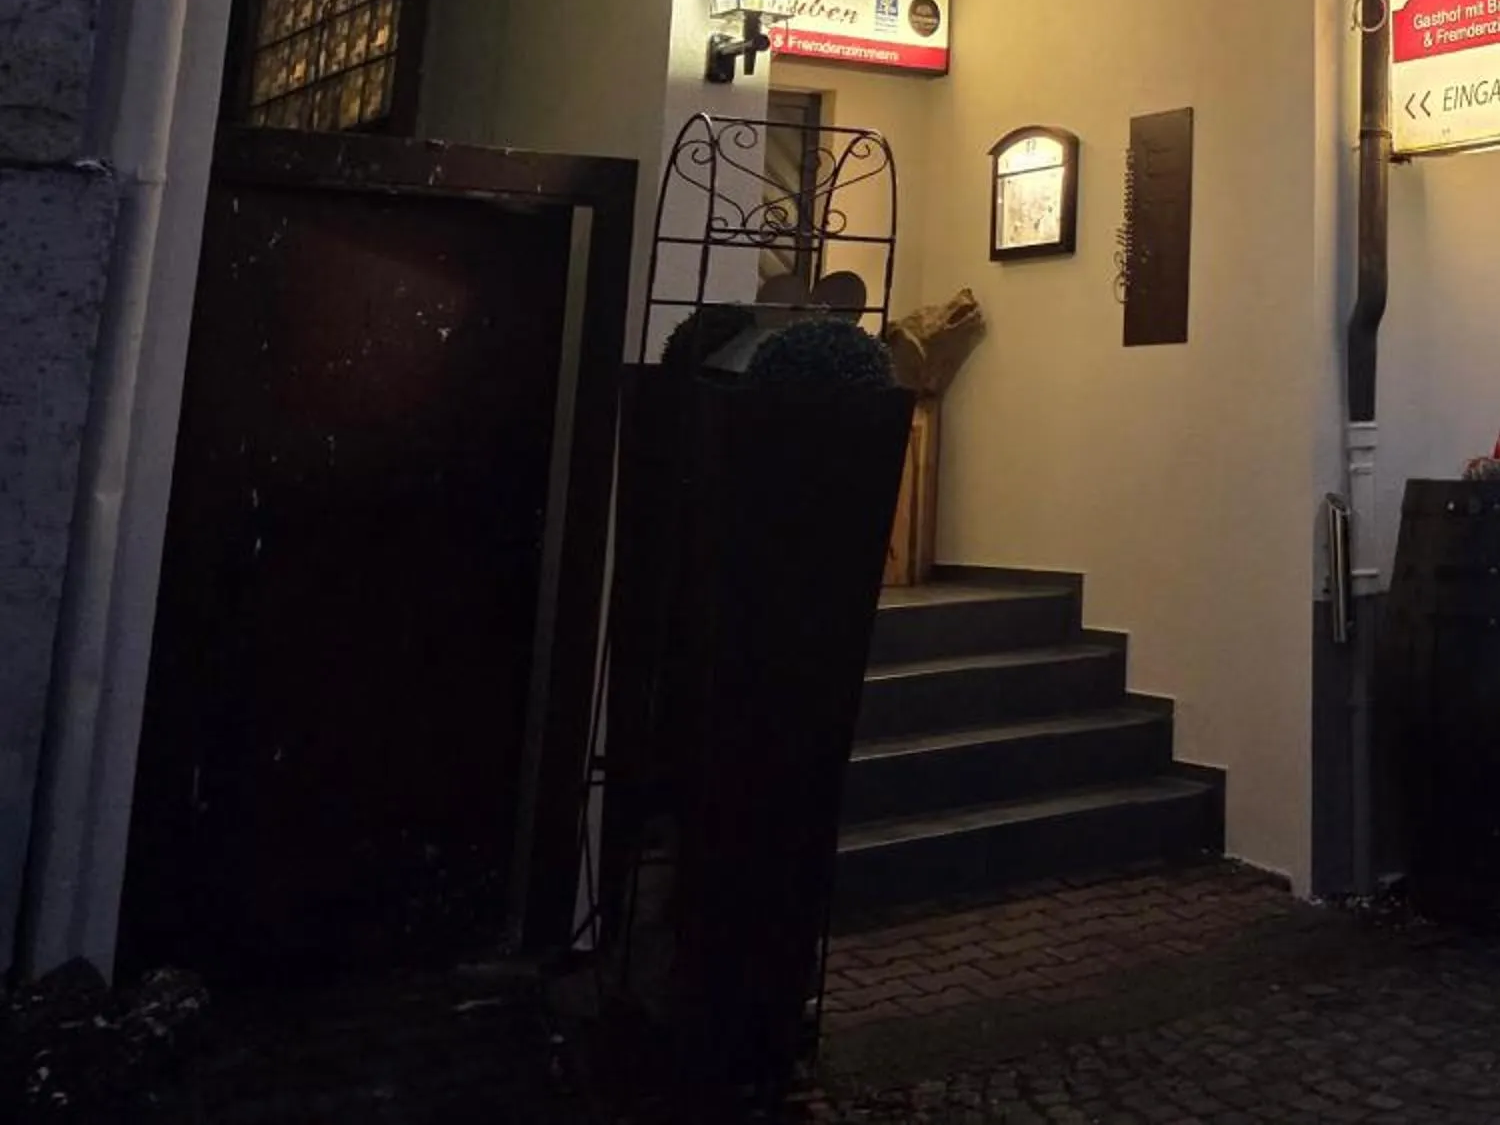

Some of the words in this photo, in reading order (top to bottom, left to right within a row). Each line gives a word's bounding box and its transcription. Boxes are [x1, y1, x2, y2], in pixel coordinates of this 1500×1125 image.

[1414, 5, 1461, 30] Gasthof
[1465, 1, 1485, 19] mit
[1424, 32, 1433, 48] &
